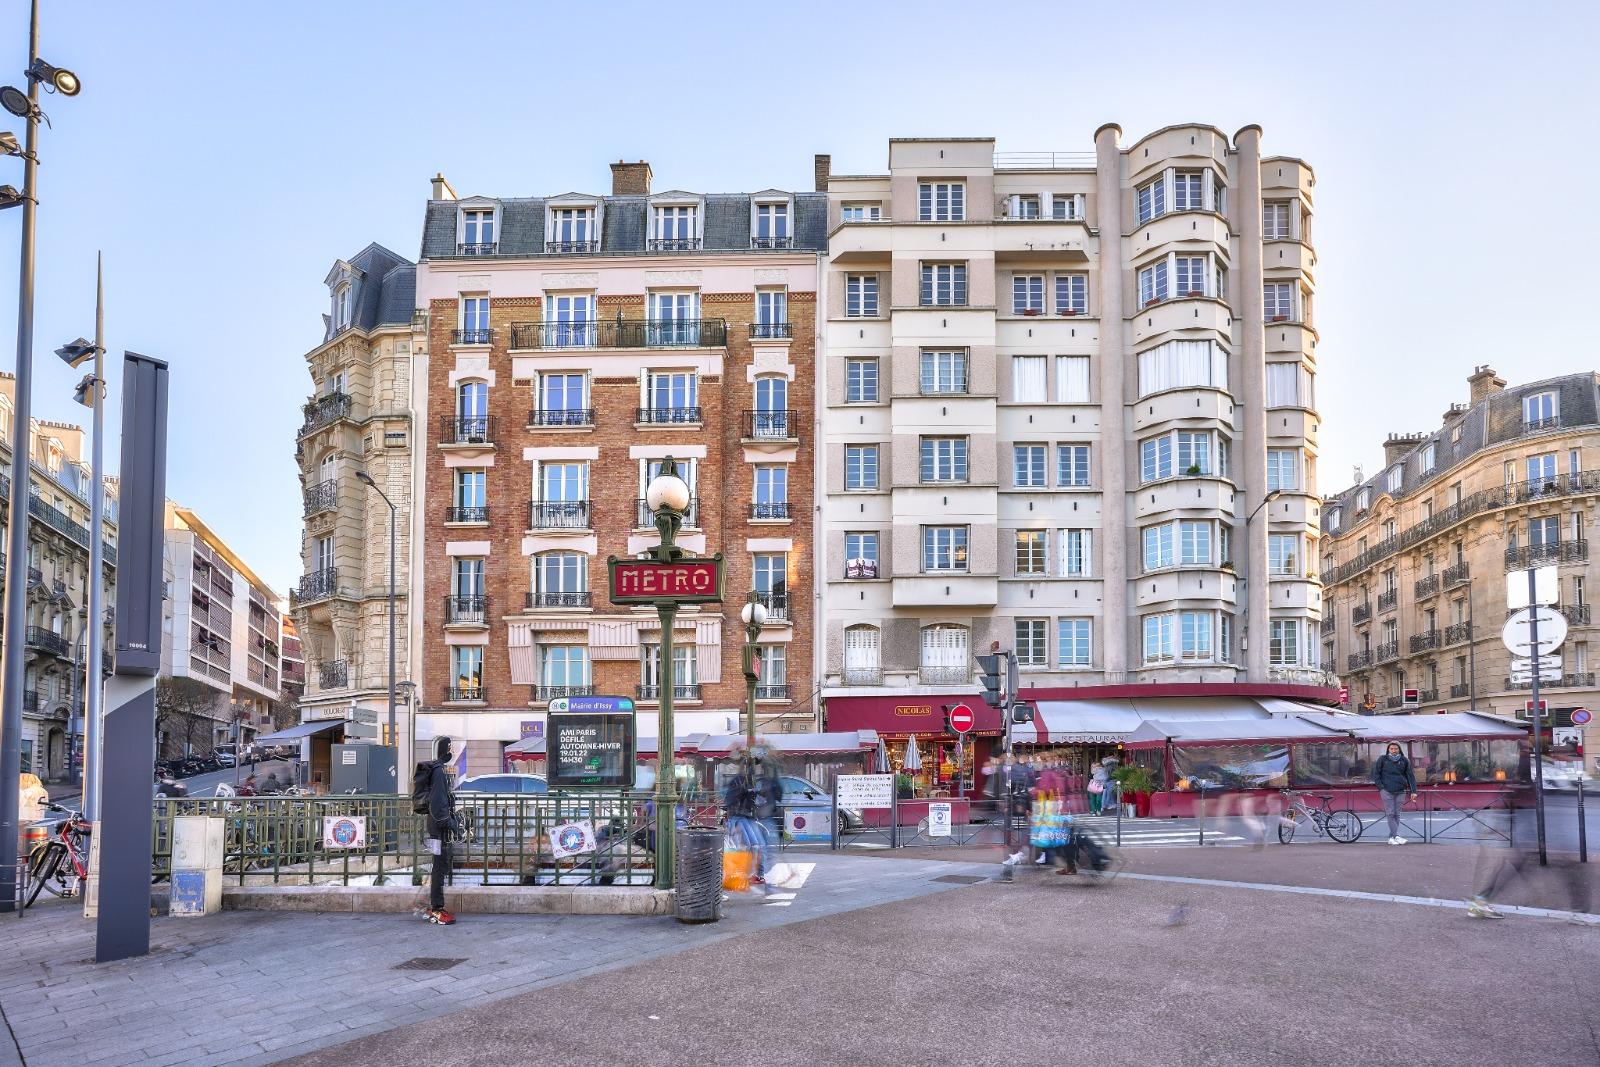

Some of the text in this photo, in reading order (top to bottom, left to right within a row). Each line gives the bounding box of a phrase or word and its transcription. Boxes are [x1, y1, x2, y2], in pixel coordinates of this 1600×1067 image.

[622, 569, 710, 592] METRO
[570, 702, 592, 710] Mairie
[593, 702, 613, 711] d'Issy
[896, 707, 931, 715] NICOLAS
[560, 742, 621, 750] AUTOMNE-HIVER
